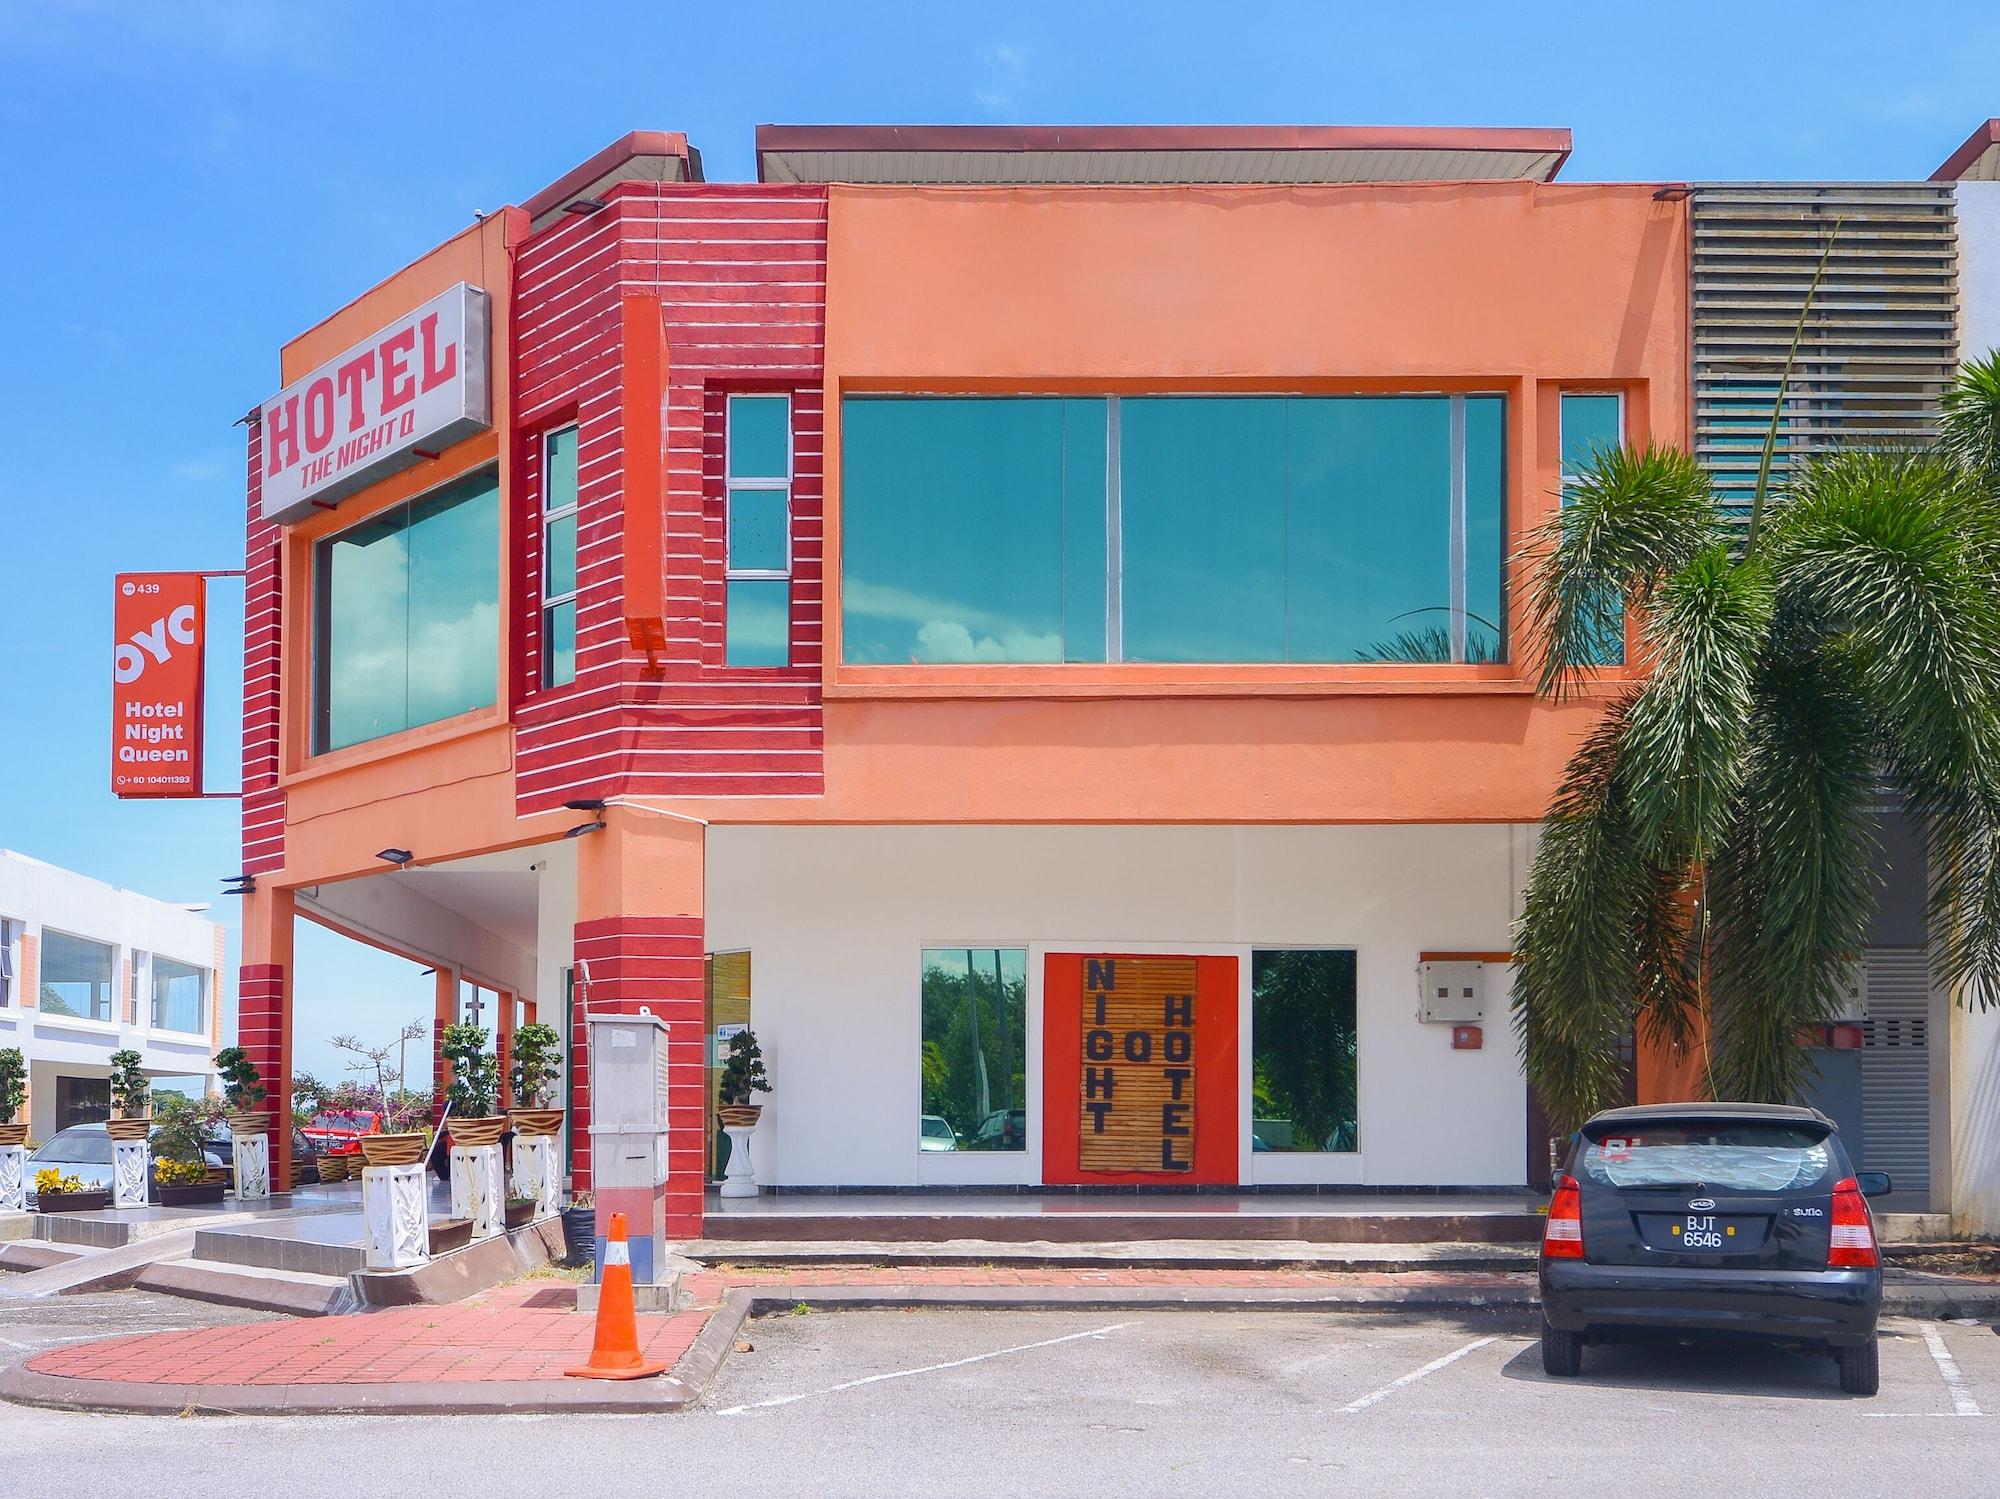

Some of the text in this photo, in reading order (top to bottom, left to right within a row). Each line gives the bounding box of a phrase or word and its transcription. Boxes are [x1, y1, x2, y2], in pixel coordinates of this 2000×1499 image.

[267, 311, 457, 478] HOTEL
[301, 450, 334, 490] THE
[336, 417, 397, 470] NIGHT
[137, 584, 160, 594] 439
[125, 701, 184, 718] Hotel
[125, 723, 184, 744] Night
[119, 745, 189, 763] Queen
[1086, 959, 1115, 1134] NIGHT
[1162, 994, 1193, 1170] HOTEL
[1687, 1216, 1715, 1231] BJT
[1683, 1232, 1722, 1248] 6546
